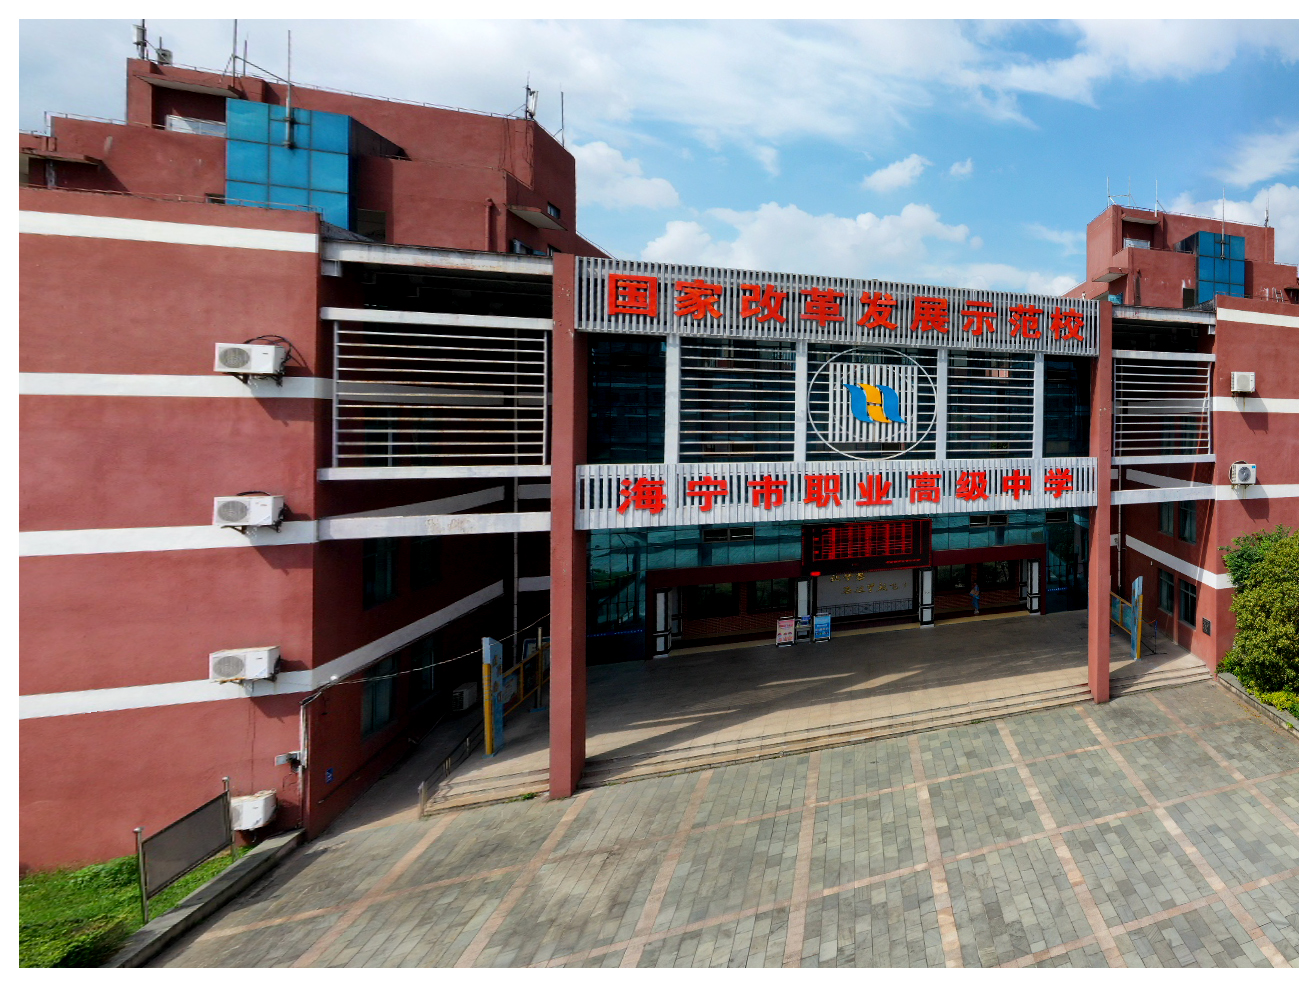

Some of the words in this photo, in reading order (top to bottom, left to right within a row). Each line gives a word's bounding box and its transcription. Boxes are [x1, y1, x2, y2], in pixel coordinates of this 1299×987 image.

[607, 273, 1085, 341] 国家改革发展示范校
[617, 468, 1073, 514] 海宁市职业高级中学
